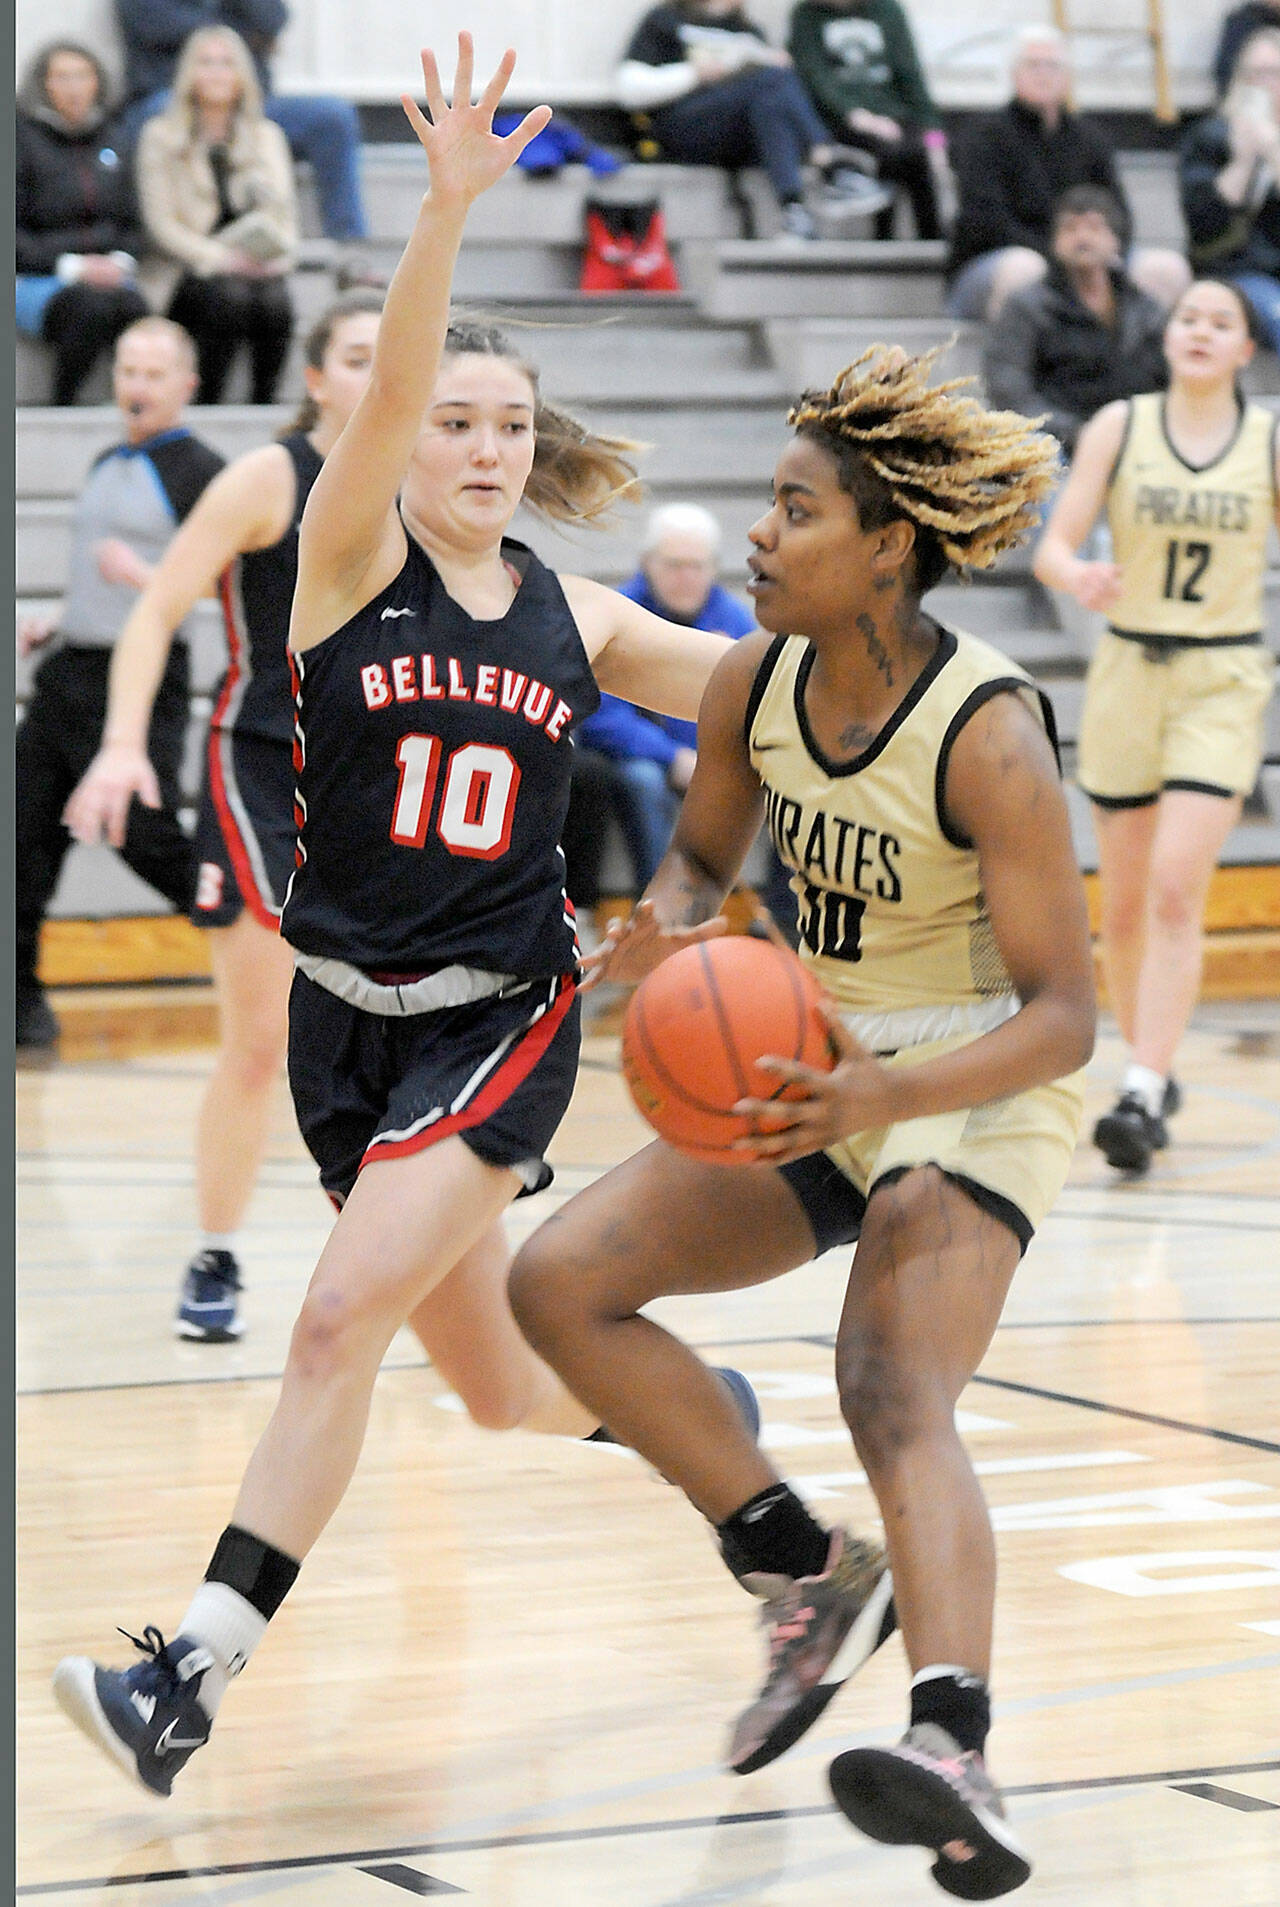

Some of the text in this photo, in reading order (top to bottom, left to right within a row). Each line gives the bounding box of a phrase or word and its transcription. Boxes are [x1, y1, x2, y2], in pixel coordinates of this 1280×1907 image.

[1134, 485, 1251, 533] PIRATES
[1164, 538, 1211, 602] 12
[361, 654, 573, 743] BELLEVUE
[390, 732, 522, 861] 10
